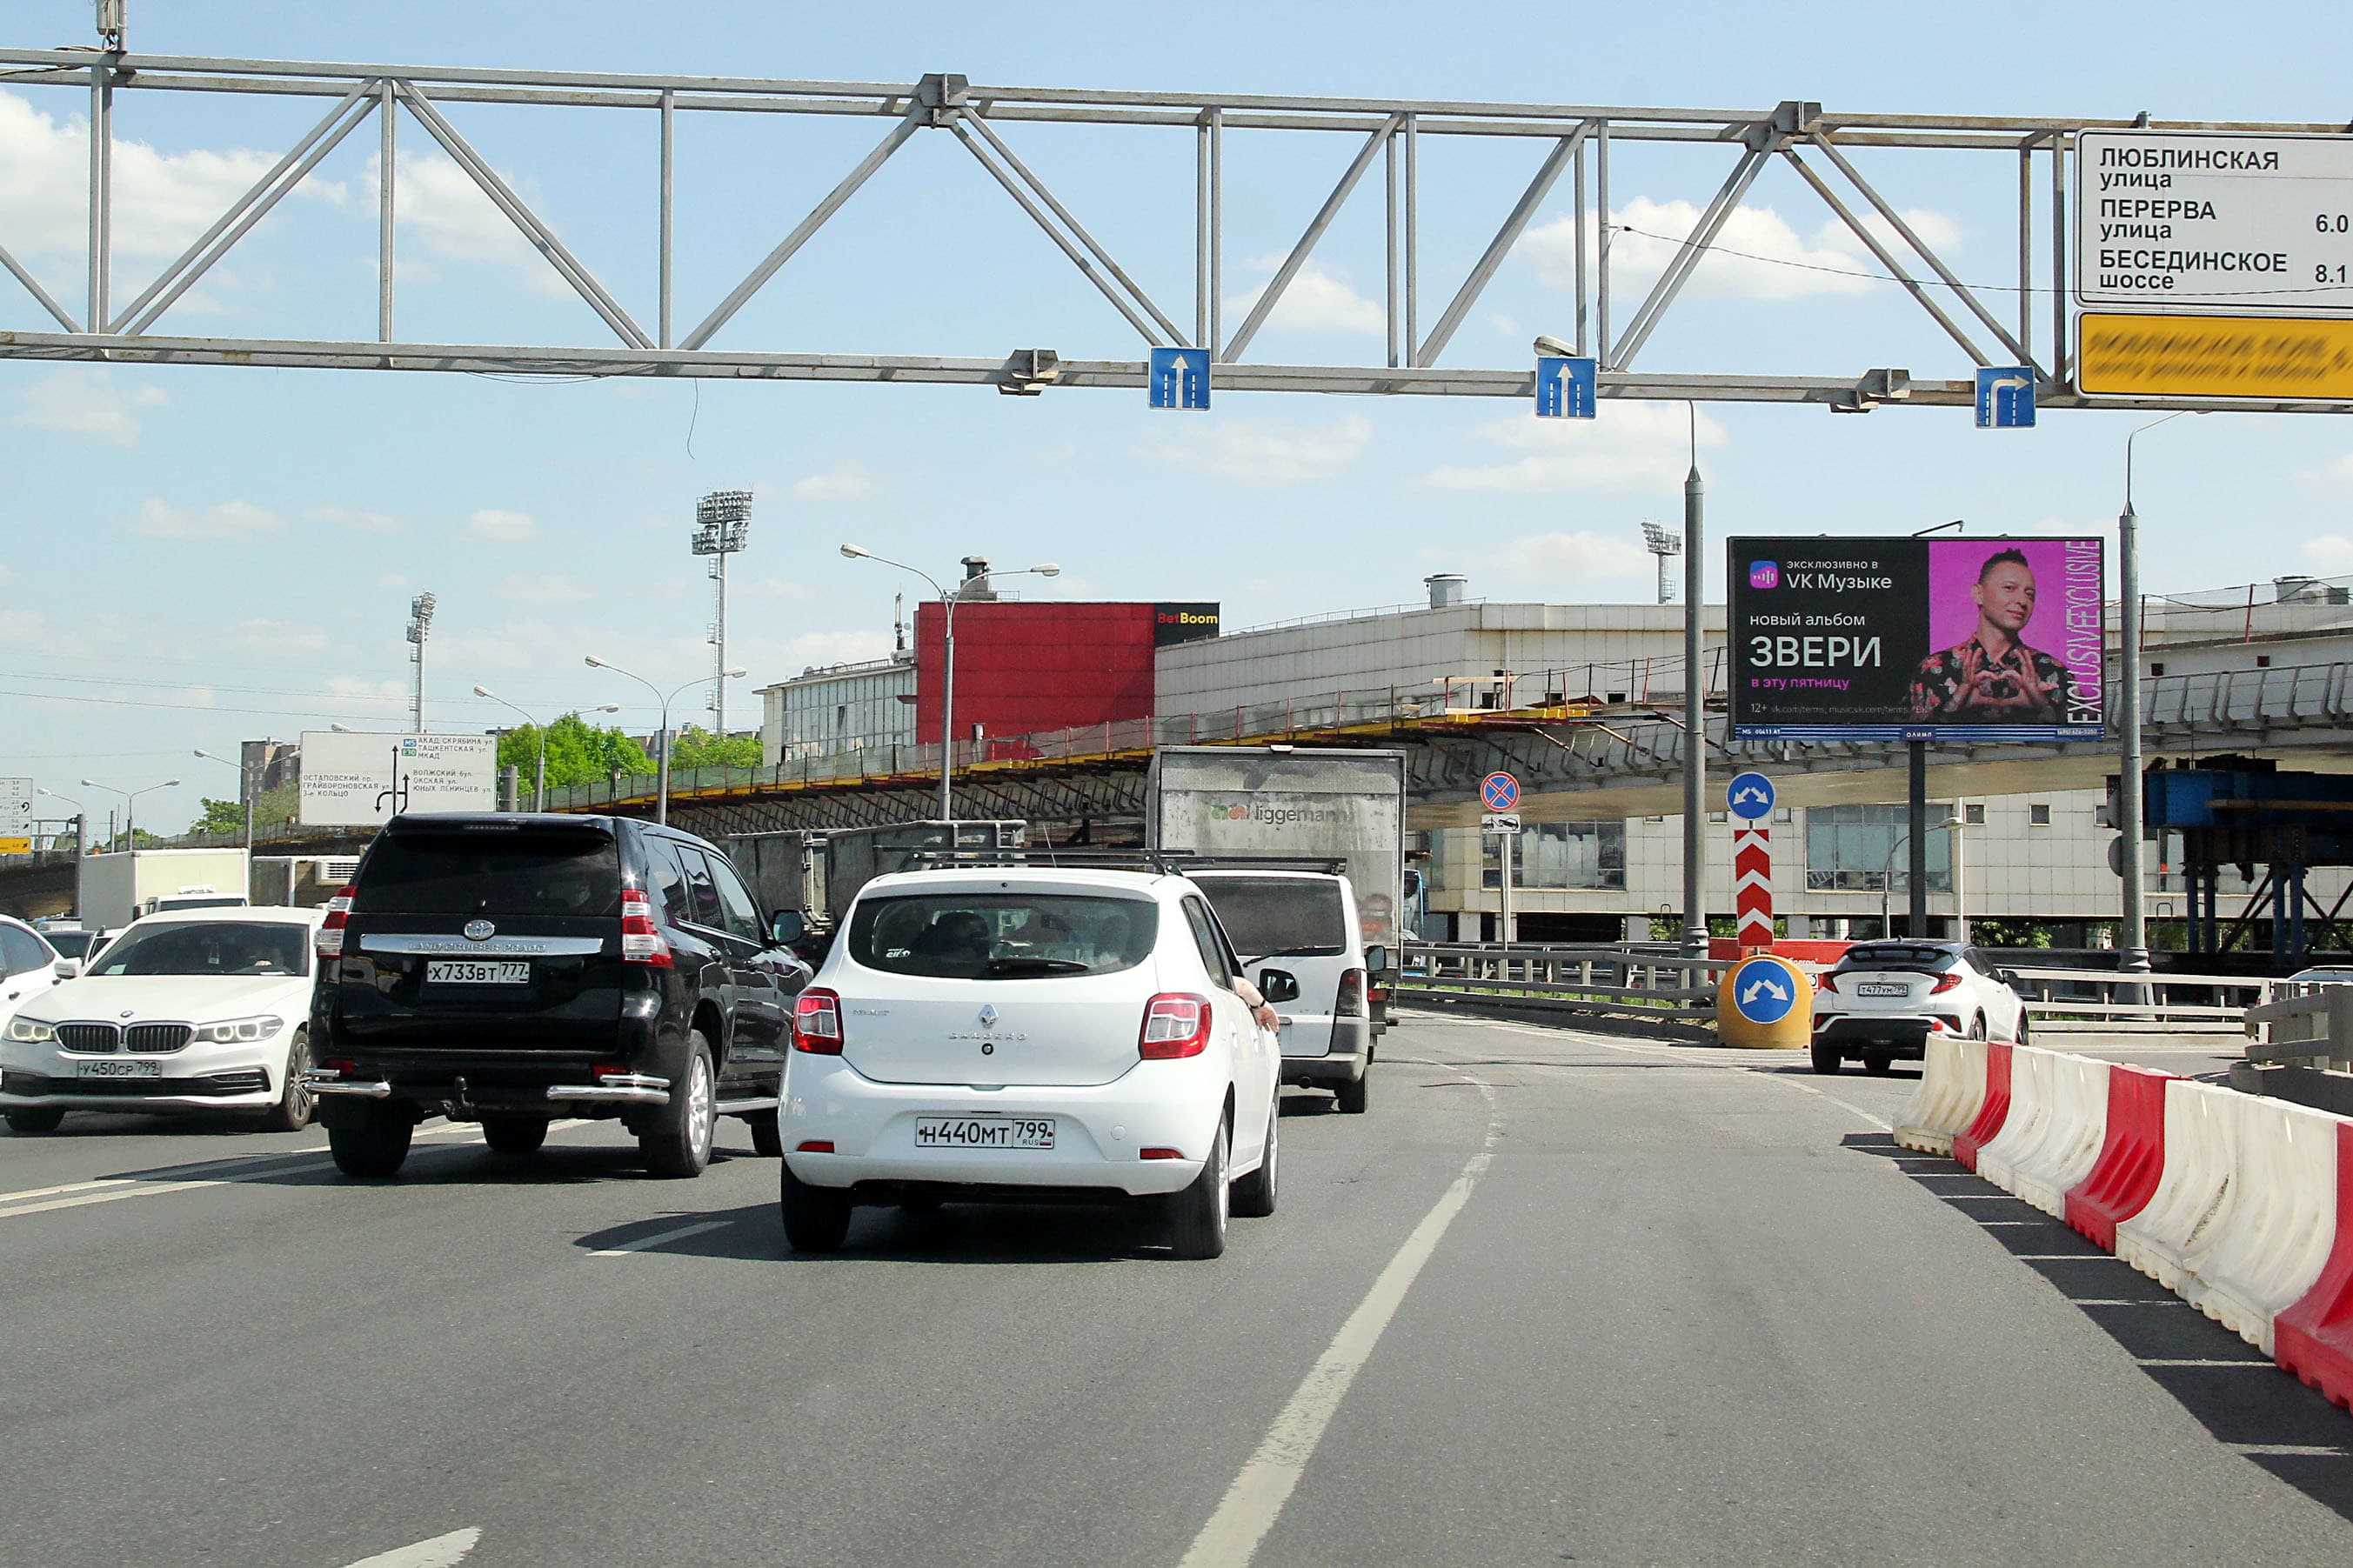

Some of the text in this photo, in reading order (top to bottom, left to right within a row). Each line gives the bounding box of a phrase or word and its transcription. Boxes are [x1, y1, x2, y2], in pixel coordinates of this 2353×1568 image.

[2099, 147, 2280, 171] ЛЮБЛИНСКАЯ
[2100, 173, 2173, 191] улица
[2100, 198, 2217, 220] ПЕРЕРВА
[2100, 224, 2173, 242] улица
[2315, 214, 2350, 234] 6.0
[2099, 249, 2288, 273] БЕСЕДИНСКОЕ
[2099, 274, 2175, 290] шоссе
[2315, 264, 2347, 284] 8.1
[1787, 561, 1878, 570] эксклюзивно в
[1787, 574, 1893, 593] VK Музыке
[1157, 611, 1218, 624] BetBoom
[1749, 612, 1866, 626] новый альбом
[1749, 636, 1882, 668] ЗВЕРИ
[1751, 678, 1850, 691] в эту пятницу
[1750, 703, 1768, 714] 12+
[412, 768, 457, 777] ВОЛЖСКИЙ
[501, 963, 526, 976] 777
[136, 1061, 157, 1072] 799
[1014, 1121, 1049, 1139] 799
